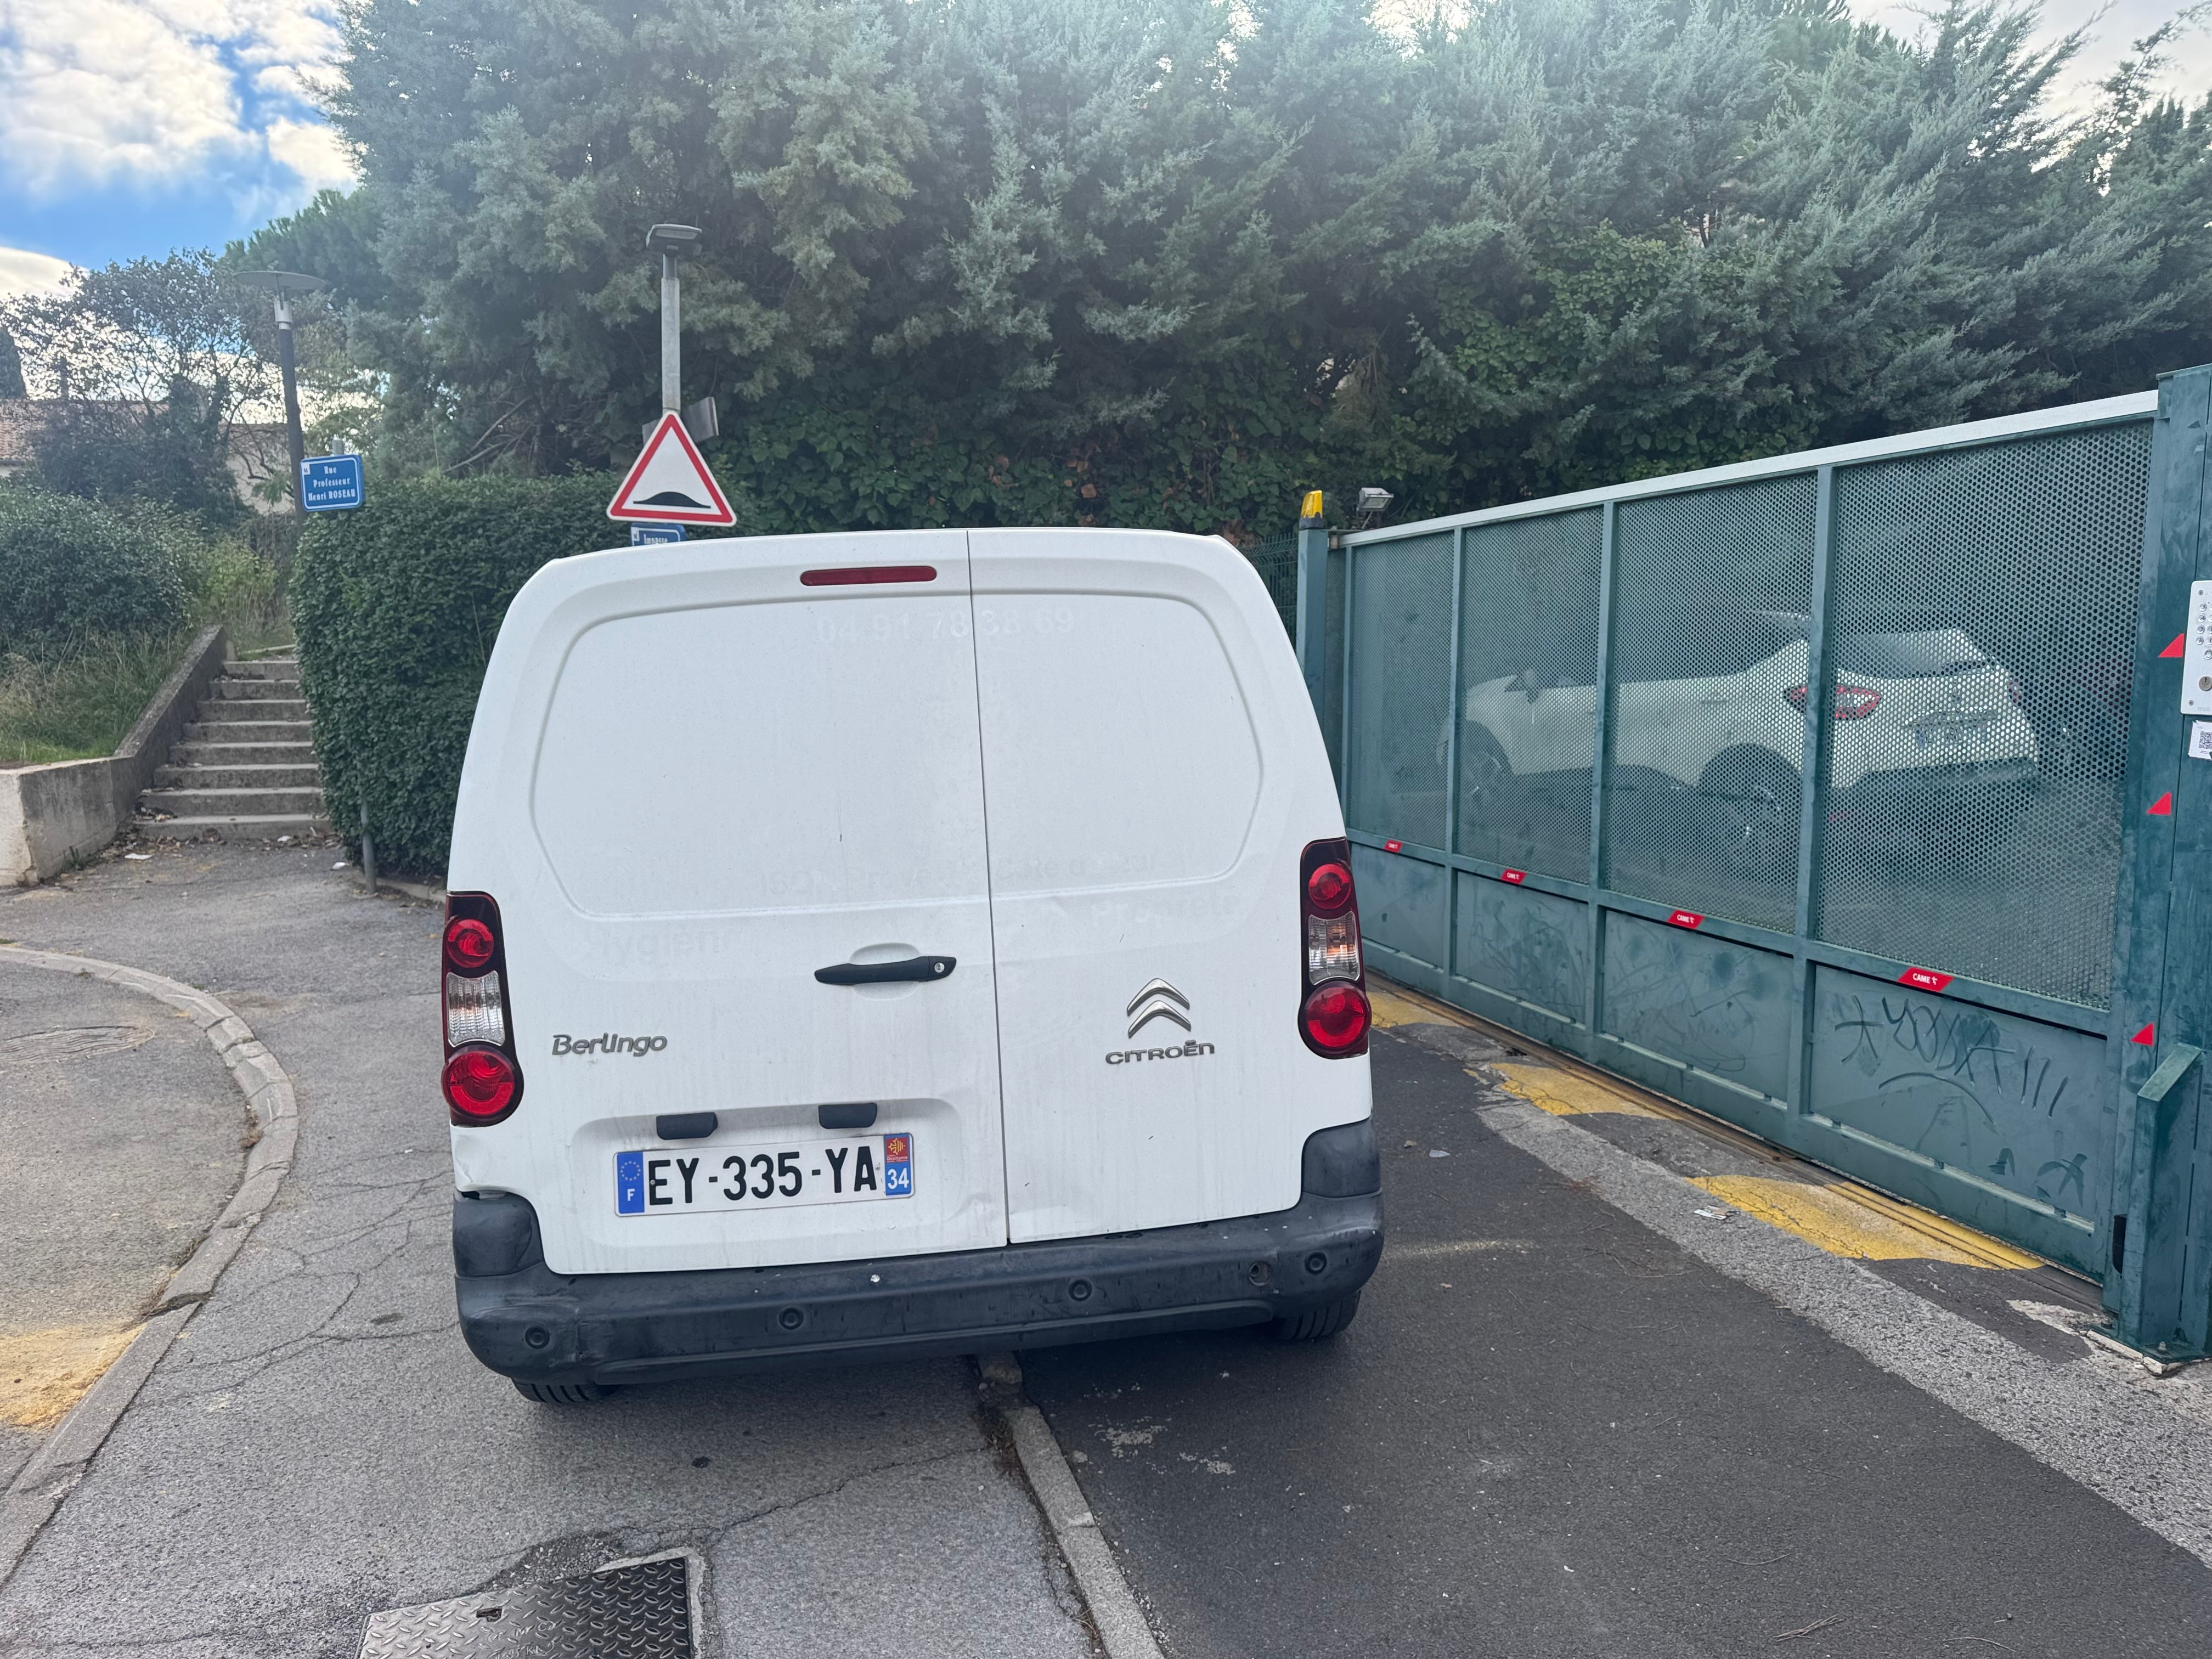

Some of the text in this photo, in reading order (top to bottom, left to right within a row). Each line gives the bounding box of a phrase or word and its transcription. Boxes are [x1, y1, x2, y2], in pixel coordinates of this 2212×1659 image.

[324, 466, 337, 475] Rue
[313, 478, 351, 488] Professeur
[308, 488, 356, 501] Henri ROSEAU
[1912, 973, 1931, 984] CAME
[552, 1032, 668, 1057] Berlingo
[1105, 1039, 1215, 1064] CITROËN
[648, 1146, 878, 1206] EY-335-YA
[887, 1167, 909, 1189] 34
[627, 1189, 635, 1201] F
